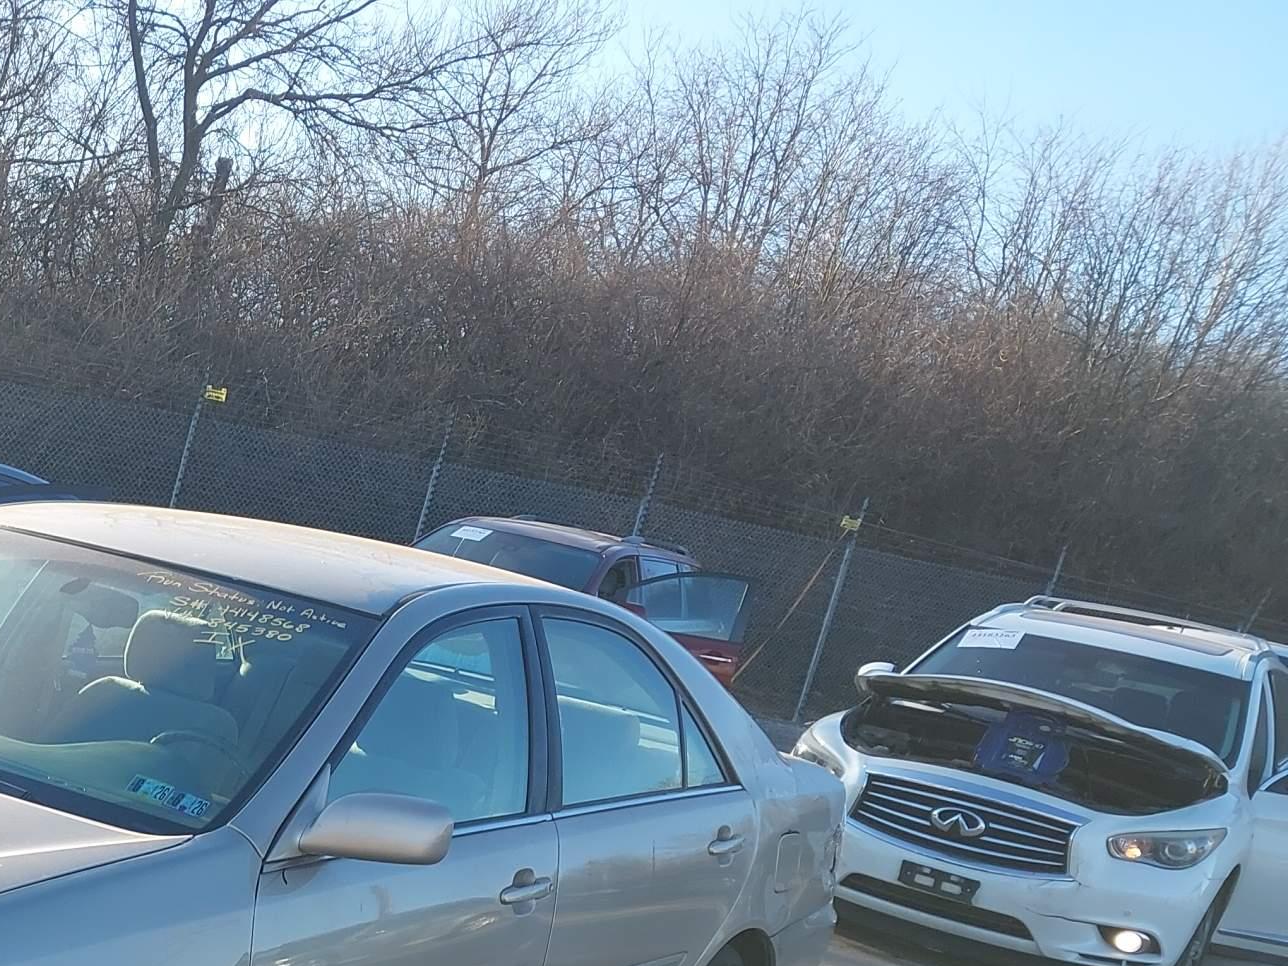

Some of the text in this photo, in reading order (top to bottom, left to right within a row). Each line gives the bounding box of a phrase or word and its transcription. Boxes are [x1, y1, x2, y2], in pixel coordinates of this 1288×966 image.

[218, 605, 311, 633] 44148568
[266, 600, 295, 614] Not
[300, 608, 347, 629] Active
[207, 617, 292, 641] 845380
